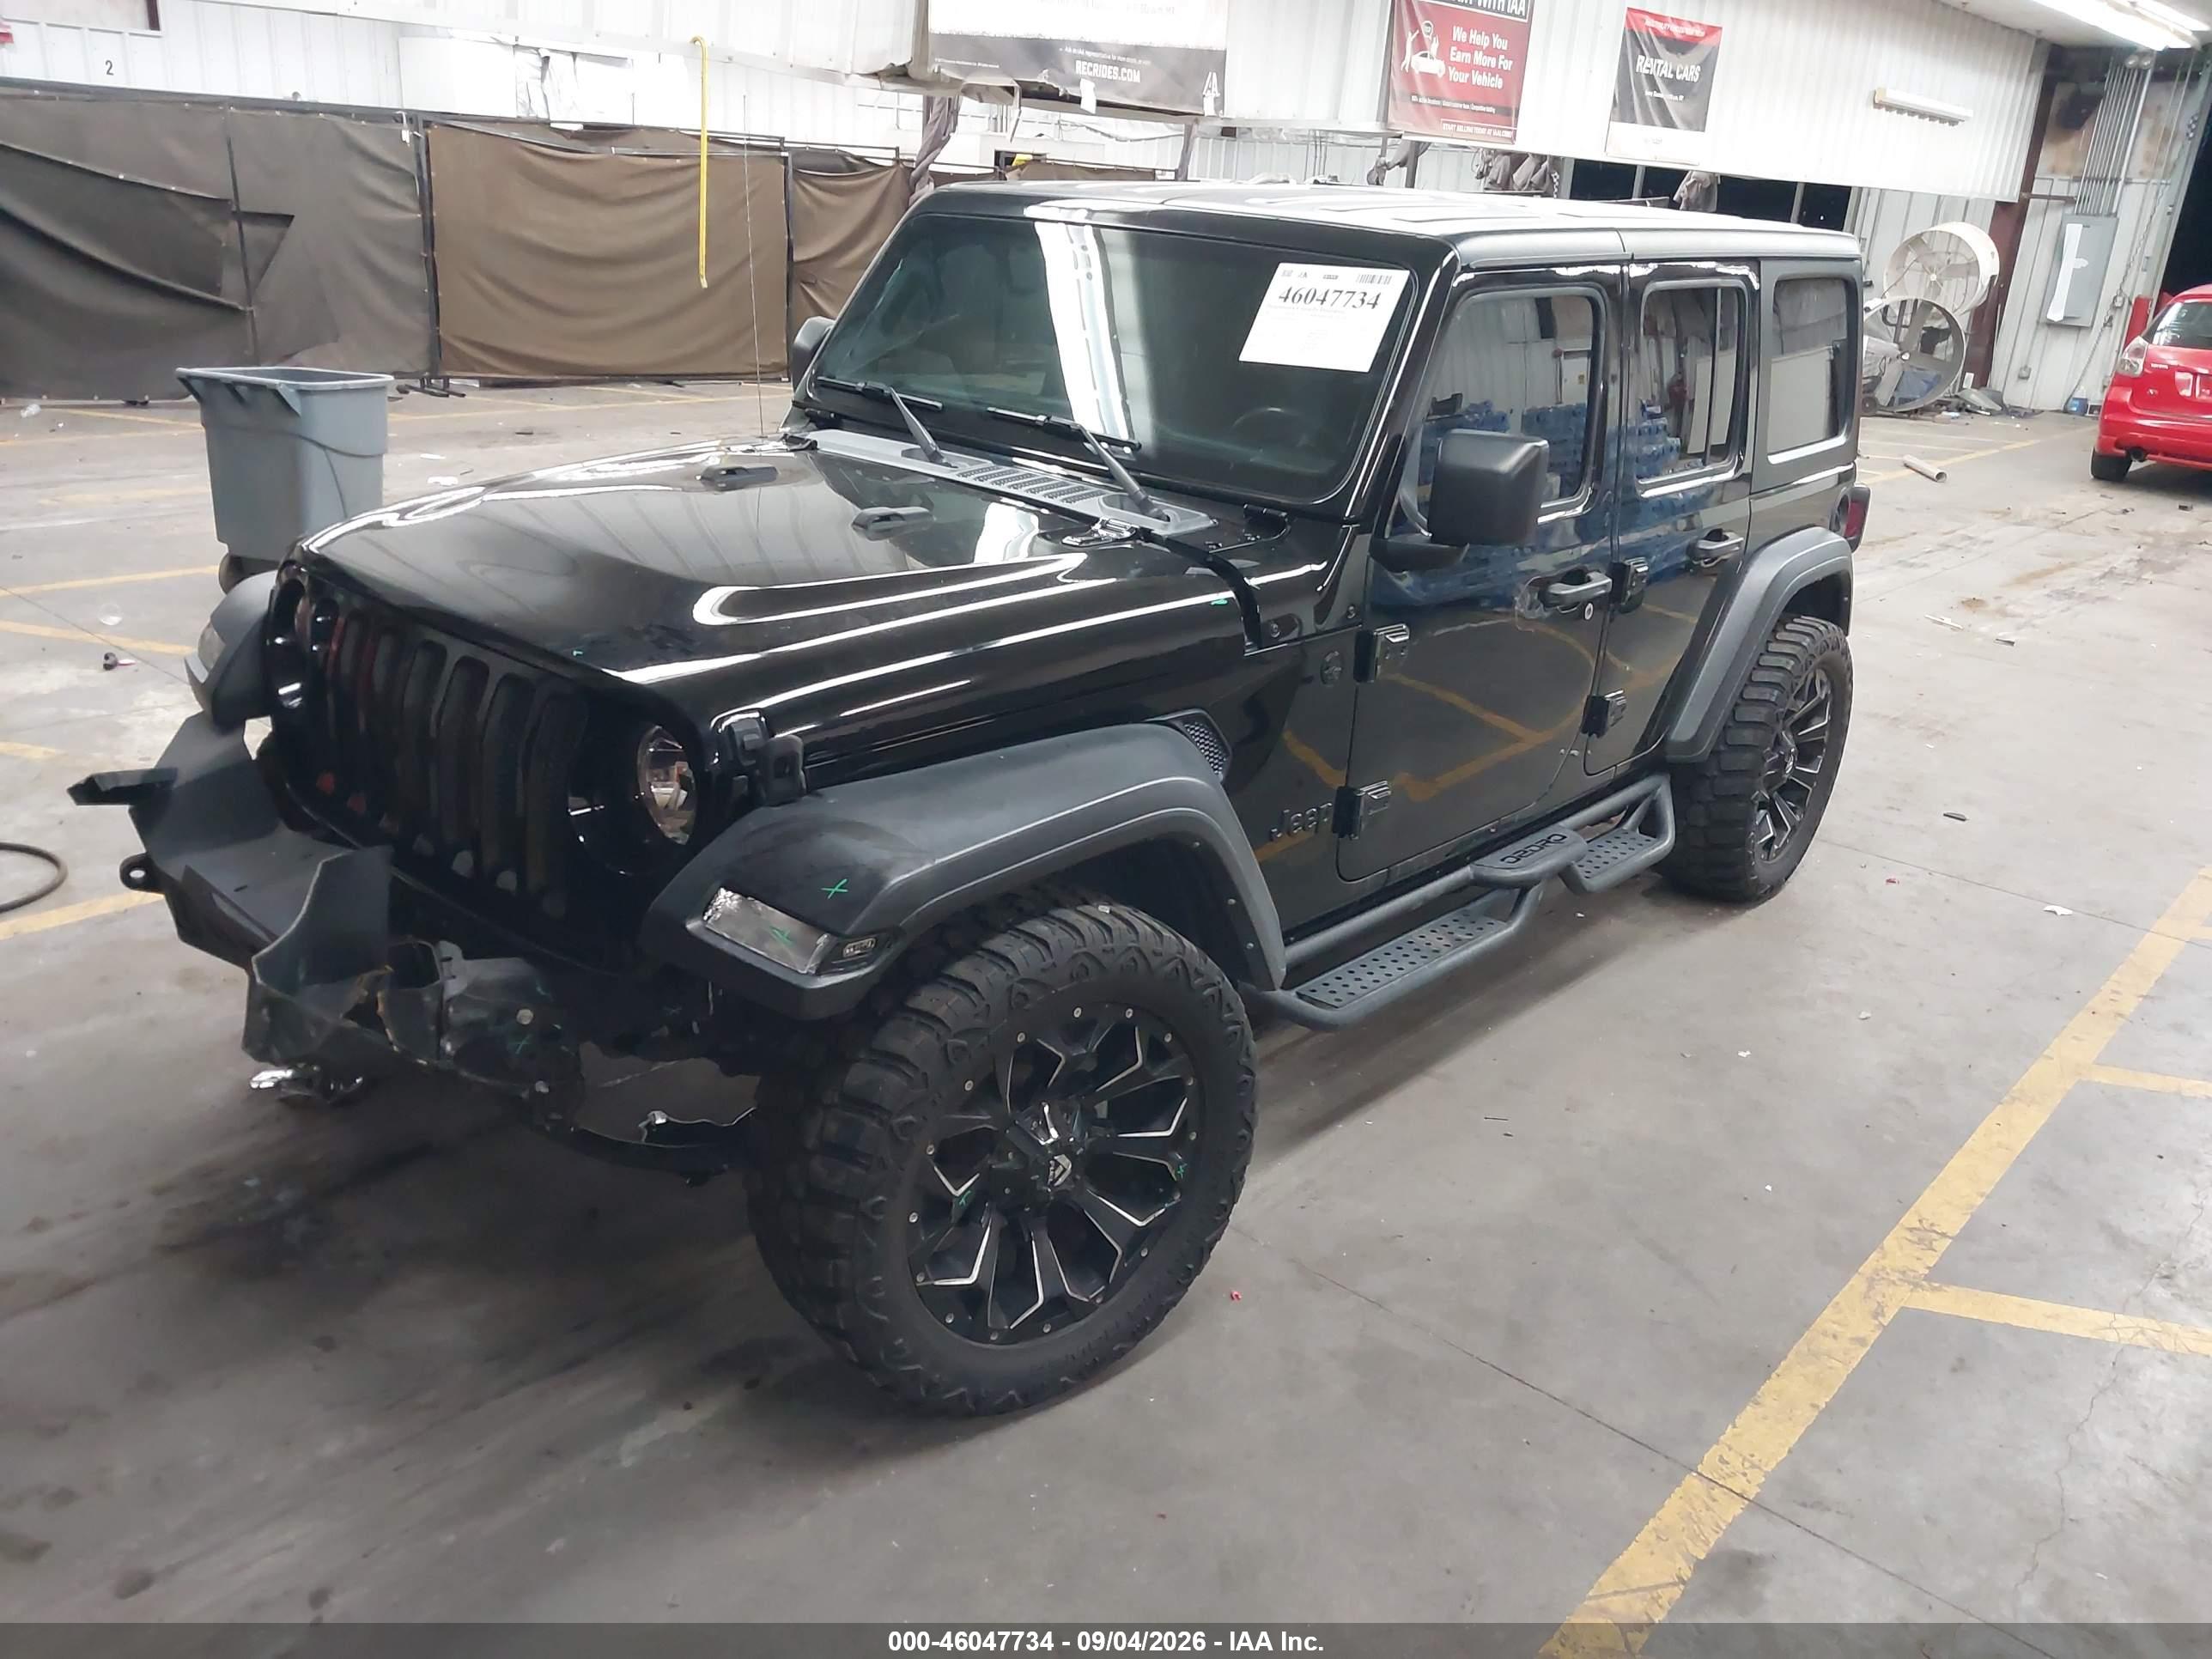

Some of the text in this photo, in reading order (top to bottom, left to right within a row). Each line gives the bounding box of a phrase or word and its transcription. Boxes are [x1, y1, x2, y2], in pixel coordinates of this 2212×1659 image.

[1507, 0, 1526, 15] IAA
[1452, 25, 1509, 51] We Help You
[105, 59, 115, 76] 2
[1449, 46, 1514, 71] Earn More For
[1636, 54, 1701, 82] RENTAL CARS
[1075, 59, 1141, 83] RECRIDES.COM
[1448, 65, 1504, 89] Your Vehicle
[1279, 286, 1382, 309] 46047734
[1269, 801, 1333, 841] Jeep
